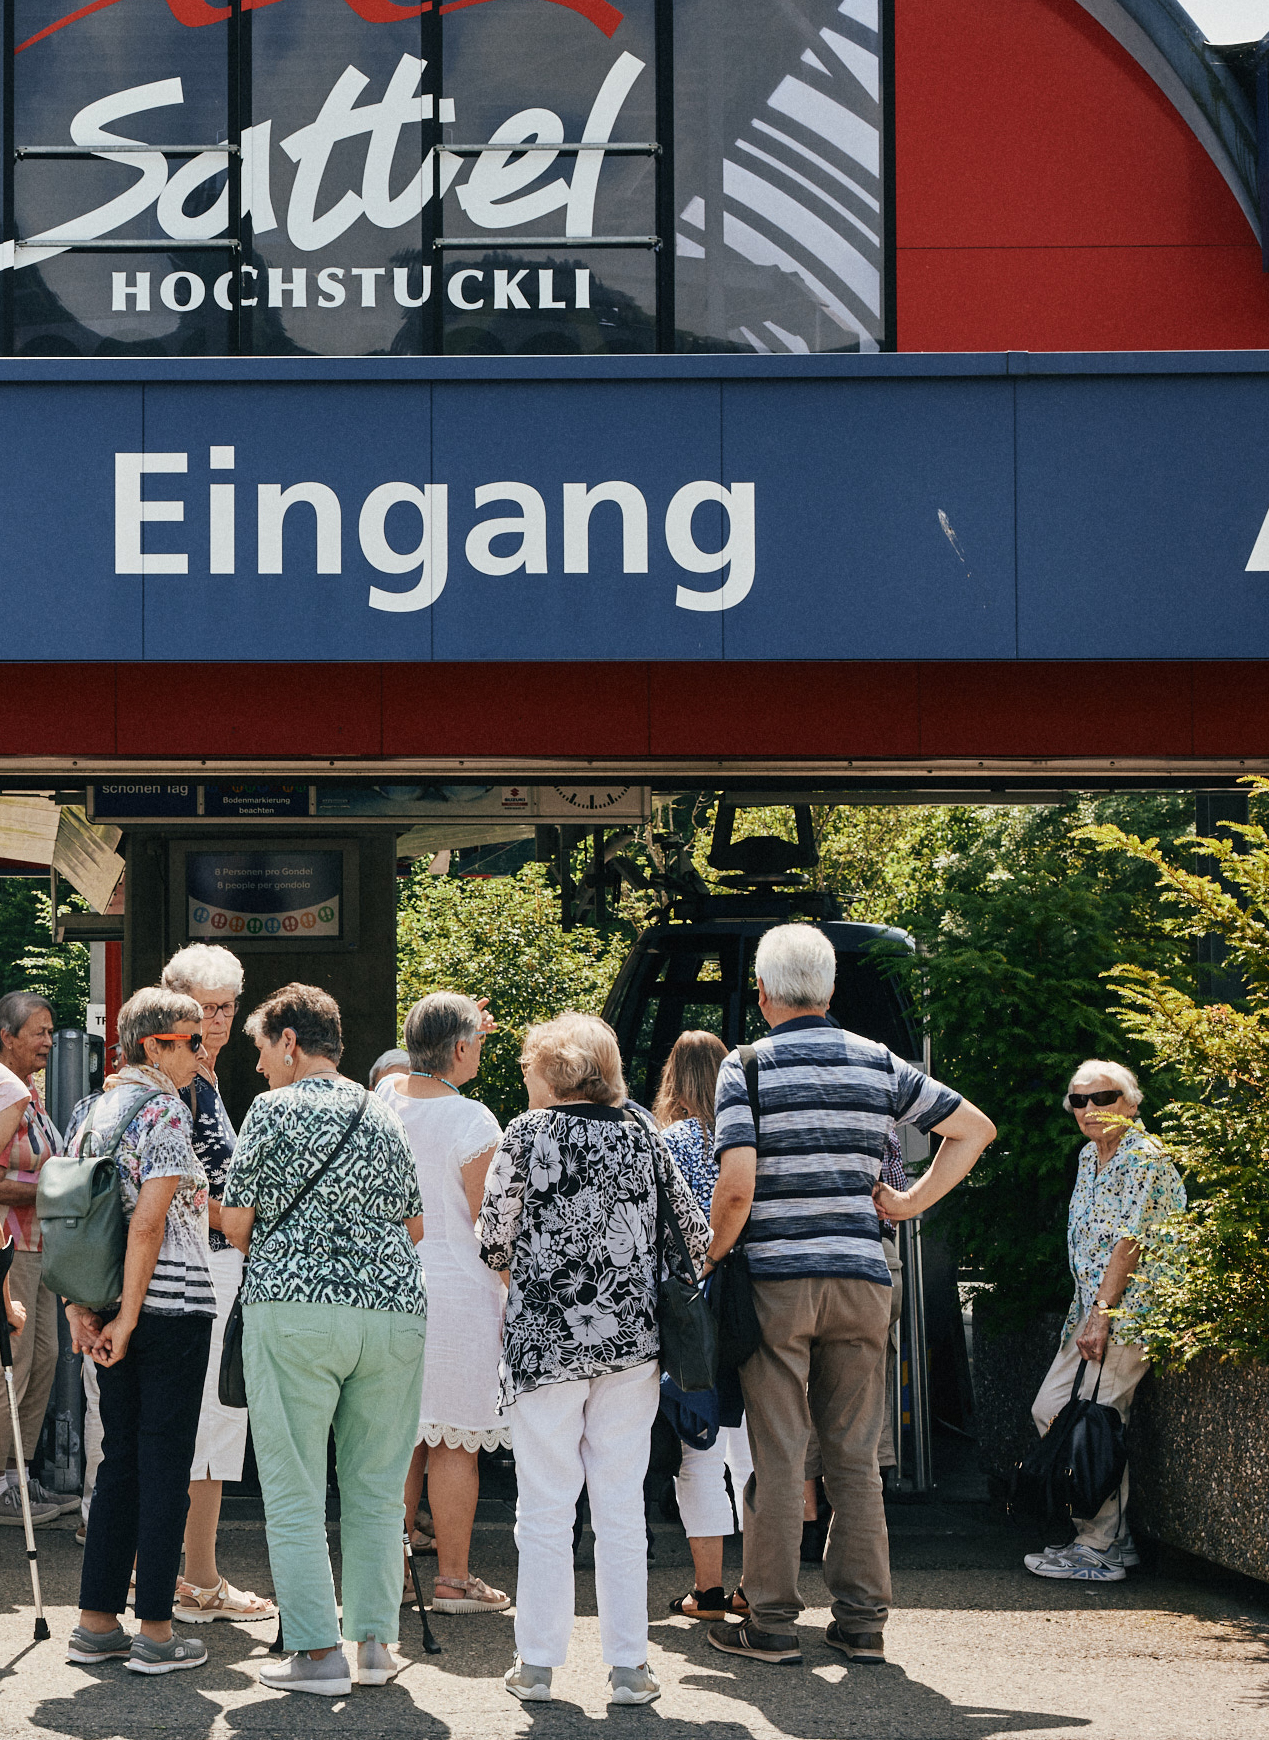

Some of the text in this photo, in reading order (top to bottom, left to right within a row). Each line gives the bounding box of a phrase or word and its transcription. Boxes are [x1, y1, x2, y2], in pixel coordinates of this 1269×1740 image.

[111, 266, 591, 312] HOCHSTUCKLI
[114, 445, 757, 613] Eingang
[222, 796, 291, 805] Bodenmarkierung
[214, 867, 313, 877] 8 Personen pro Gondel
[217, 881, 311, 891] 8 people per gondola
